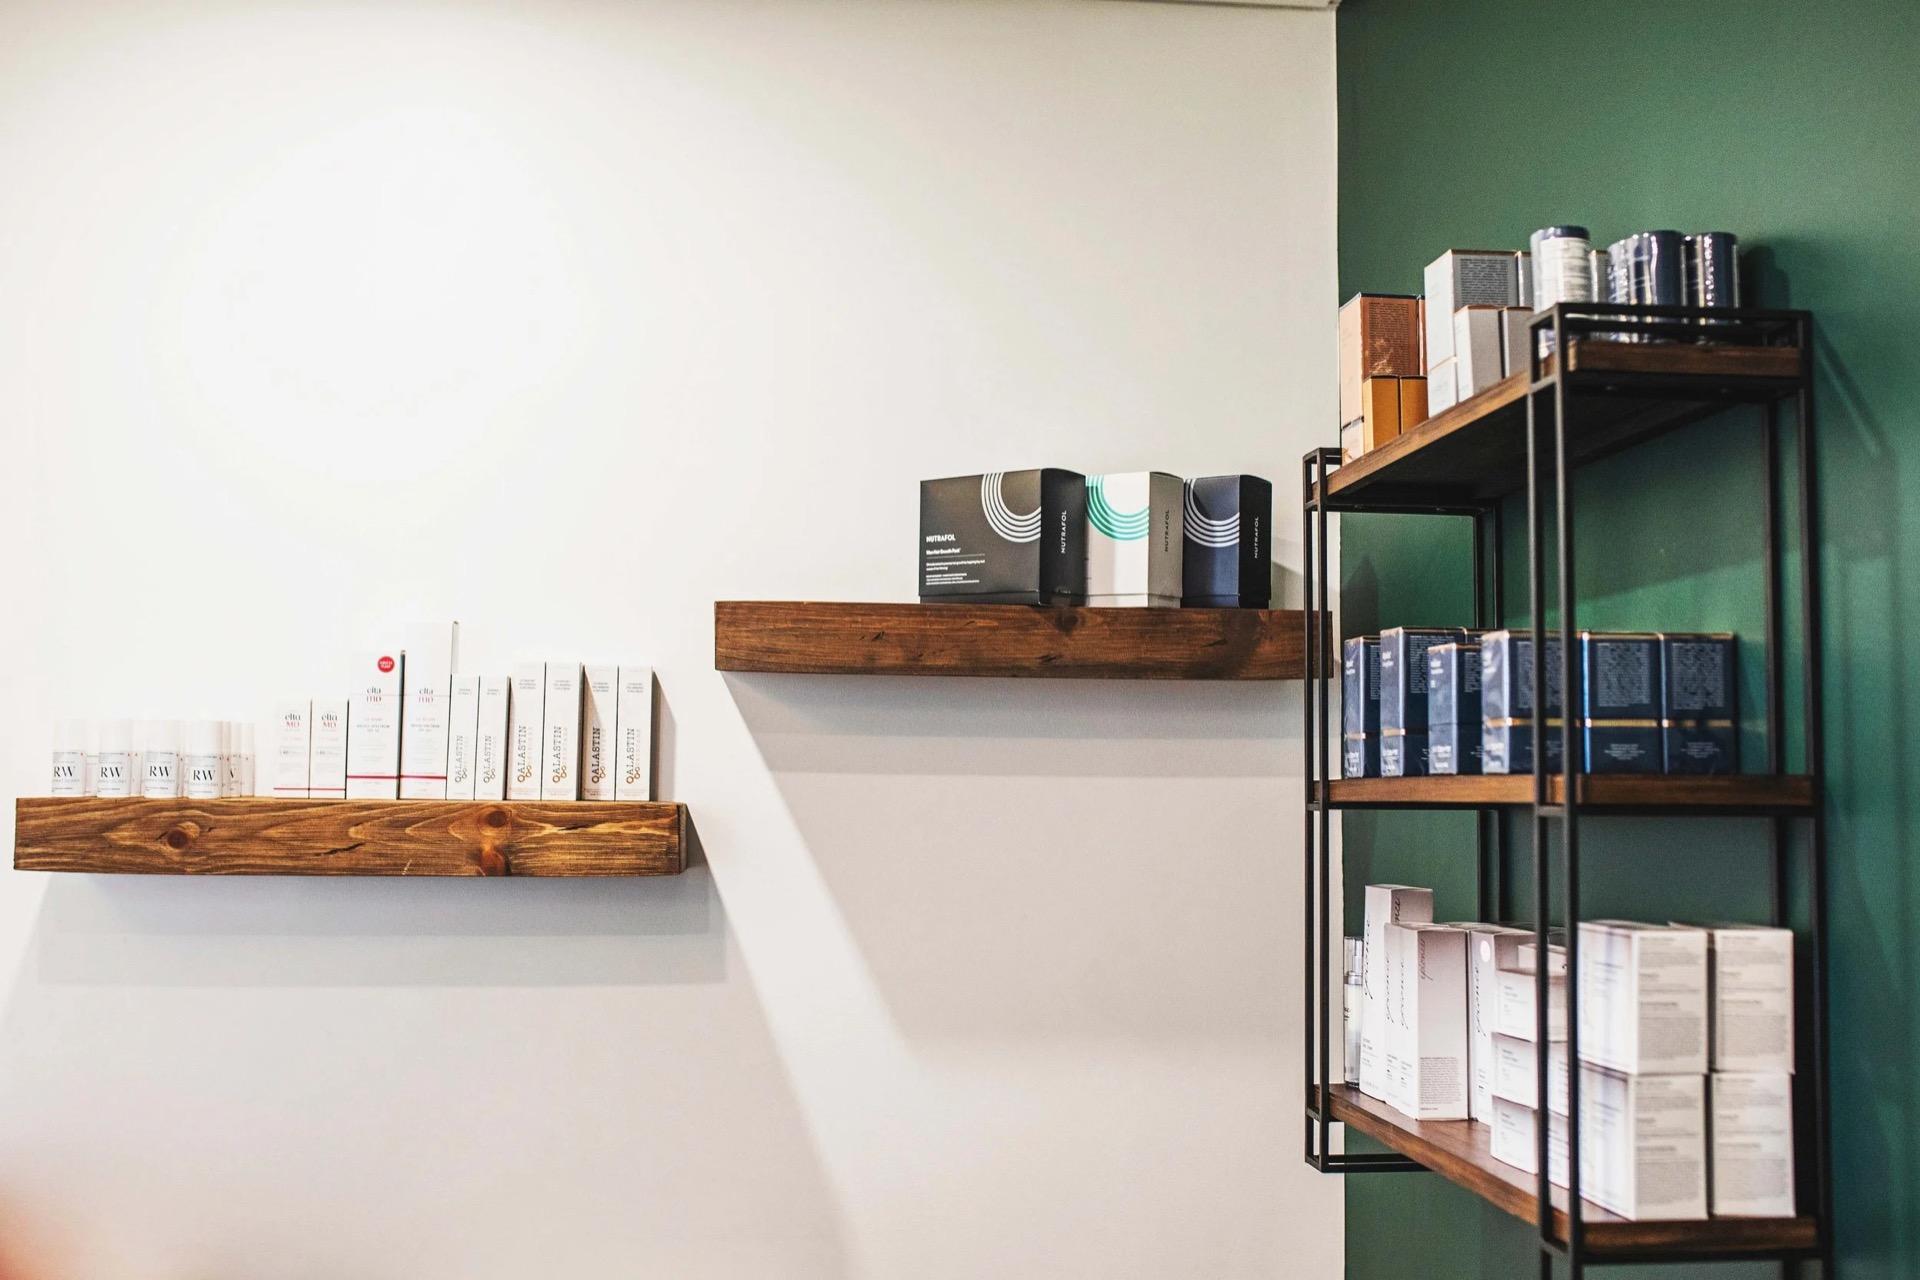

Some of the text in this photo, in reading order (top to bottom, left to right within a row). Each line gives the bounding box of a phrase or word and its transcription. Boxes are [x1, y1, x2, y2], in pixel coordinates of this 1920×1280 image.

[925, 533, 956, 543] NUTRAFOL
[53, 766, 74, 778] RW
[100, 766, 122, 778] RW
[149, 765, 170, 777] RW
[193, 769, 215, 781] RW
